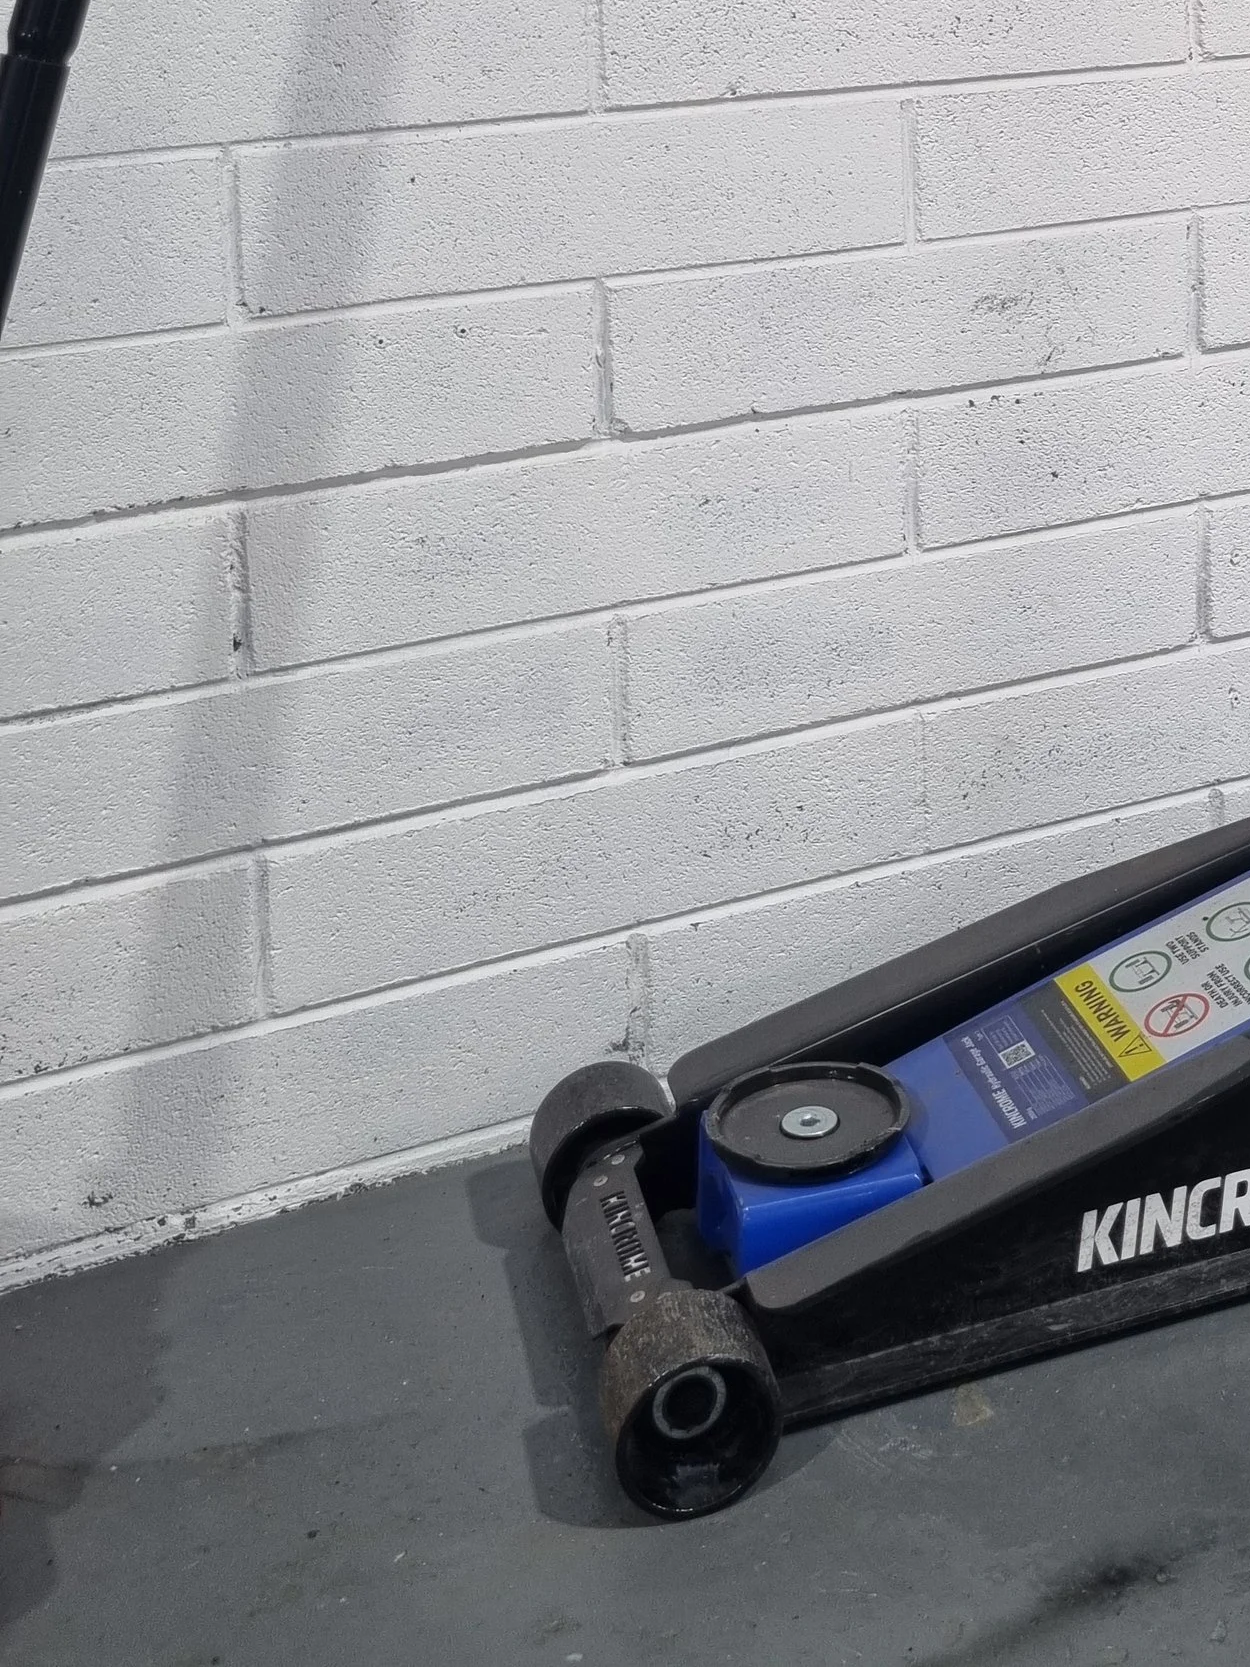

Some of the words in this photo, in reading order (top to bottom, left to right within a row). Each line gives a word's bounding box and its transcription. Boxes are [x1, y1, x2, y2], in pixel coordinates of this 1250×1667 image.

[1164, 940, 1180, 954] TWO
[1174, 935, 1200, 959] SUPPORT
[1185, 931, 1209, 952] STANDS
[1175, 952, 1189, 964] USE
[1206, 971, 1225, 987] FROM
[1215, 963, 1230, 975] USE
[1200, 980, 1213, 990] OR
[1207, 988, 1229, 1008] DEATH
[1219, 985, 1243, 1006] INJURY
[1073, 978, 1132, 1041] WARNING
[960, 1035, 974, 1049] Jack
[968, 1046, 987, 1066] Garage
[992, 1087, 1026, 1129] KINCROME
[600, 1189, 651, 1283] KINCROME
